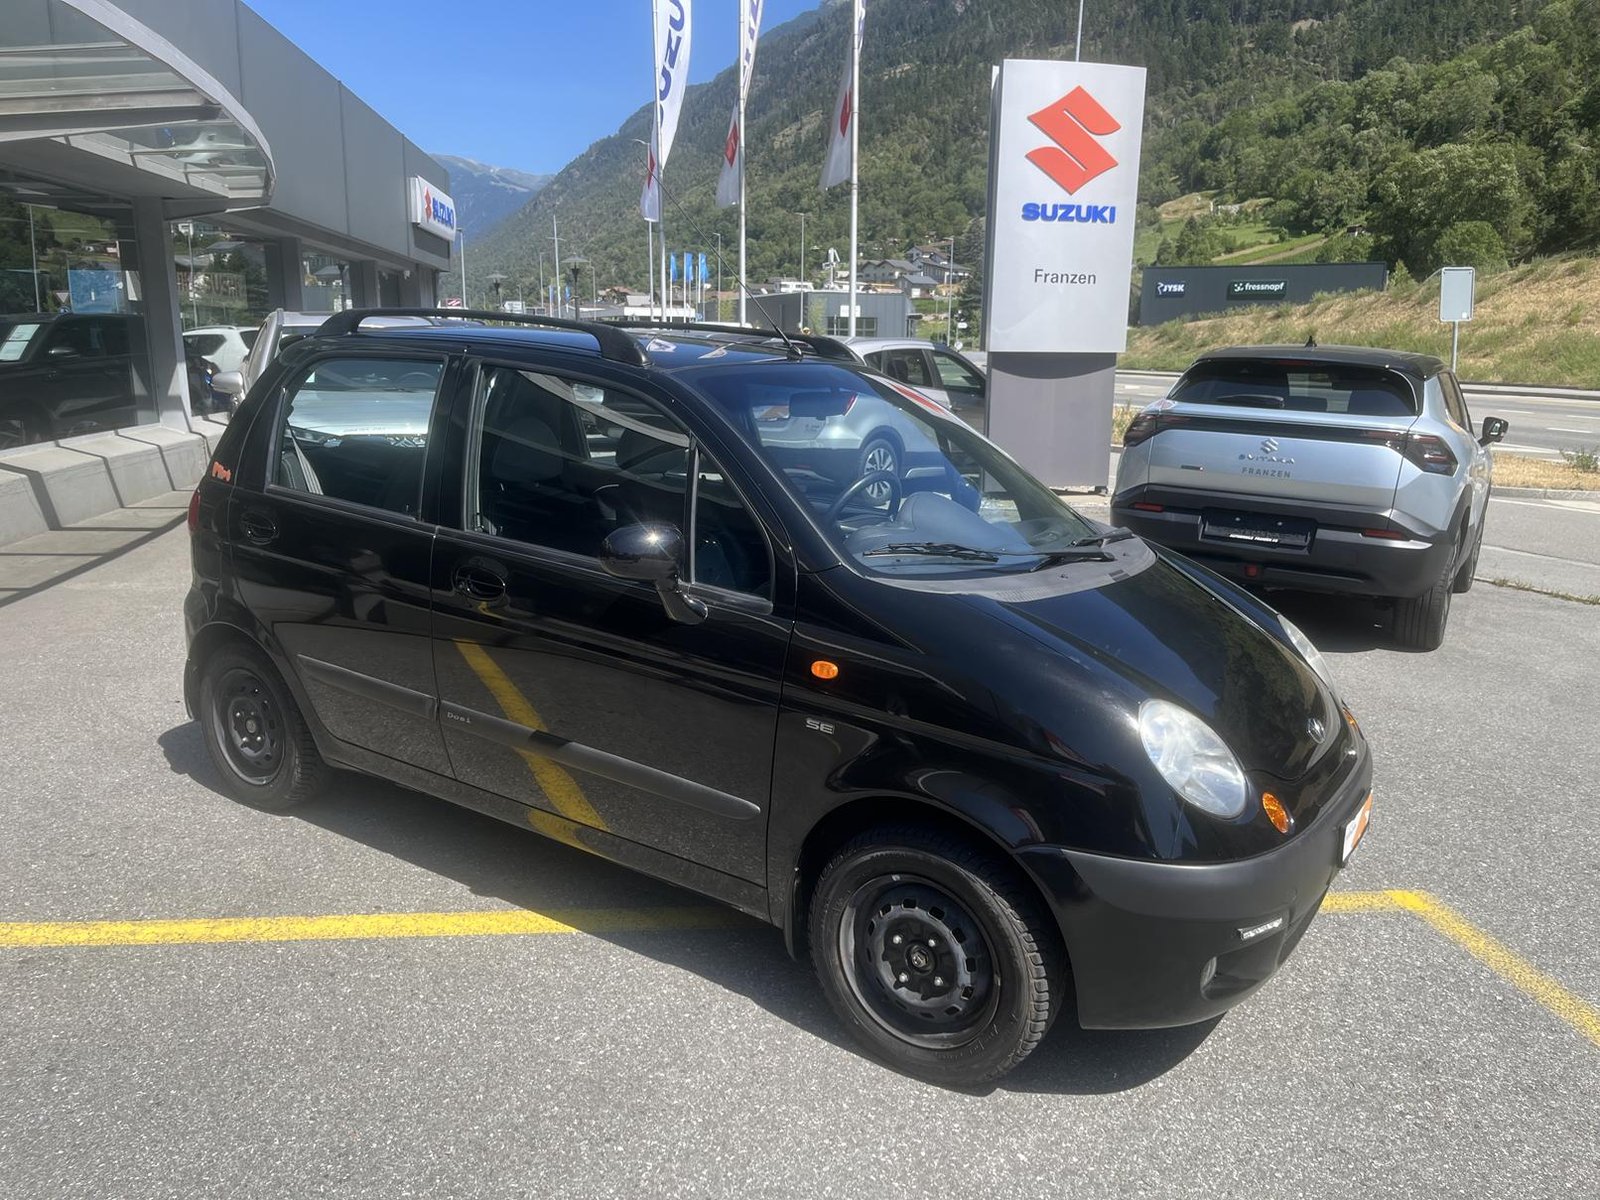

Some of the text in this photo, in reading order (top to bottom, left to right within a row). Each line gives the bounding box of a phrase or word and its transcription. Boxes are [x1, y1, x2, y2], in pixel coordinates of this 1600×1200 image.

[1021, 203, 1116, 224] SUZUKI
[1034, 268, 1096, 284] Franzen
[1163, 283, 1185, 293] JYSK
[1244, 281, 1285, 292] fressnapf
[1241, 467, 1292, 478] FRANZEN
[806, 718, 834, 735] SE
